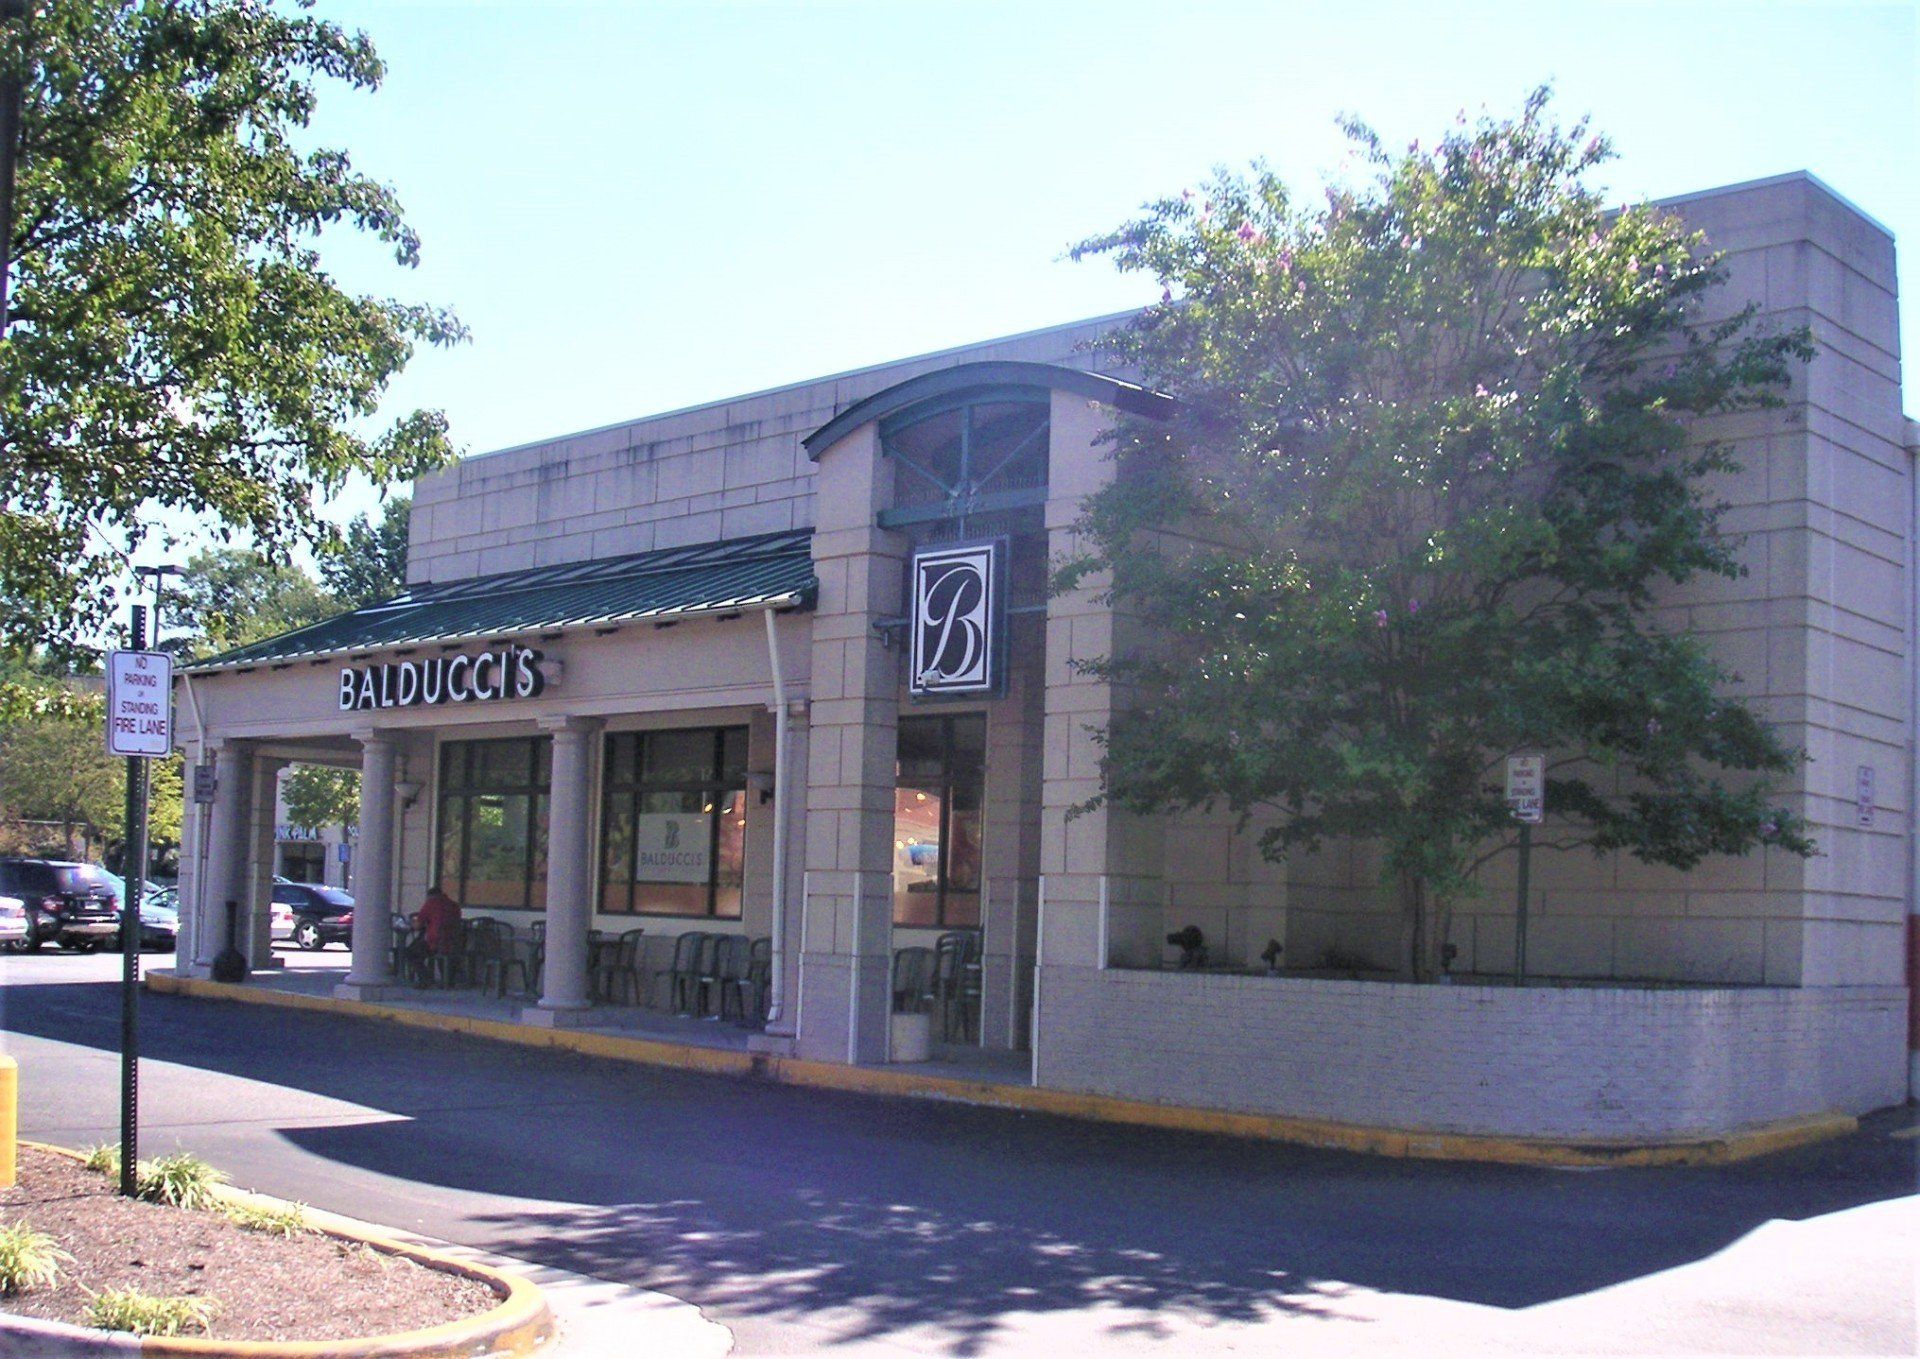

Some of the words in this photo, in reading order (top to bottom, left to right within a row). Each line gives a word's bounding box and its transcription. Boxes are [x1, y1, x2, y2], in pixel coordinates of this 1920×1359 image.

[136, 656, 147, 669] NO
[125, 673, 157, 687] PARKING
[339, 645, 535, 711] BALDUCCI'S
[121, 701, 159, 716] STANDING
[115, 717, 136, 734] FIRE
[139, 720, 166, 736] LANE
